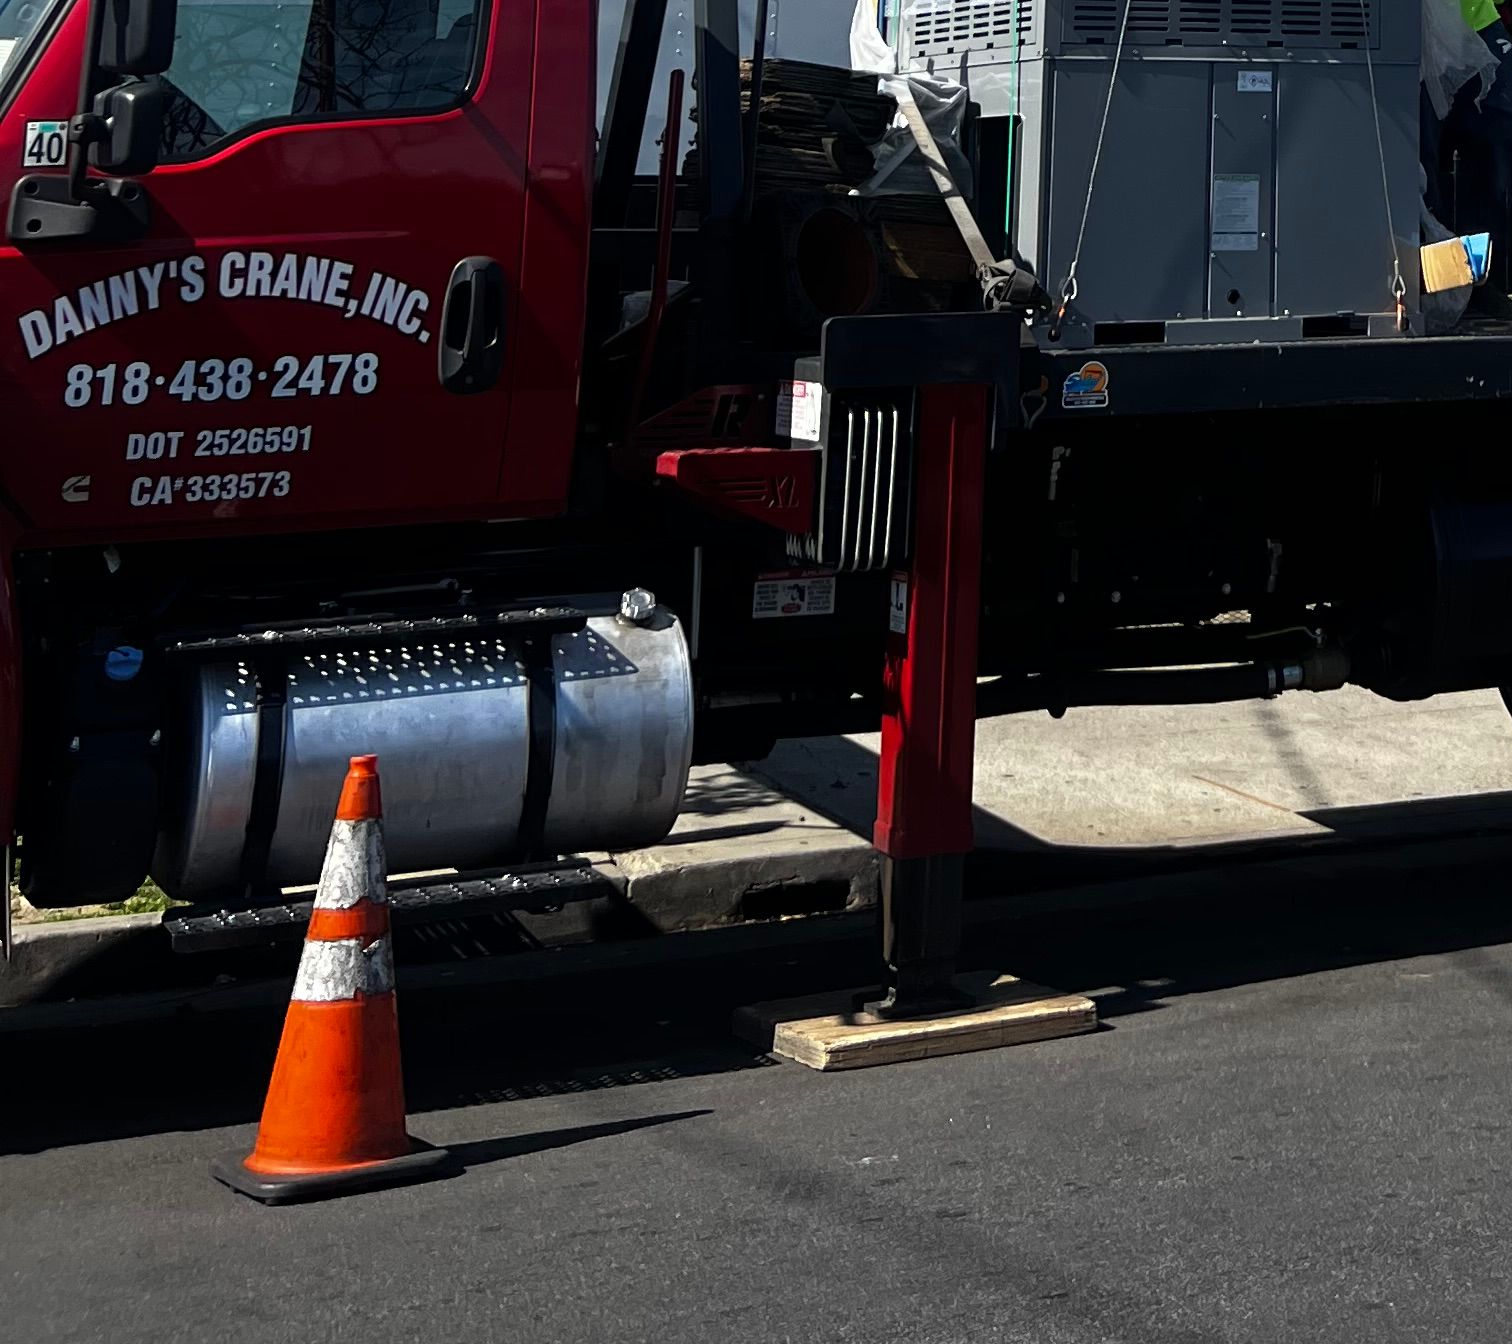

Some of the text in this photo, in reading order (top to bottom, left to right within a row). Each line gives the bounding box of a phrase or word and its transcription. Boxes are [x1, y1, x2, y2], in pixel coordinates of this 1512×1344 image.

[27, 132, 64, 164] 40
[18, 255, 205, 359] DANNY'S
[126, 426, 312, 460] DOT 2526591
